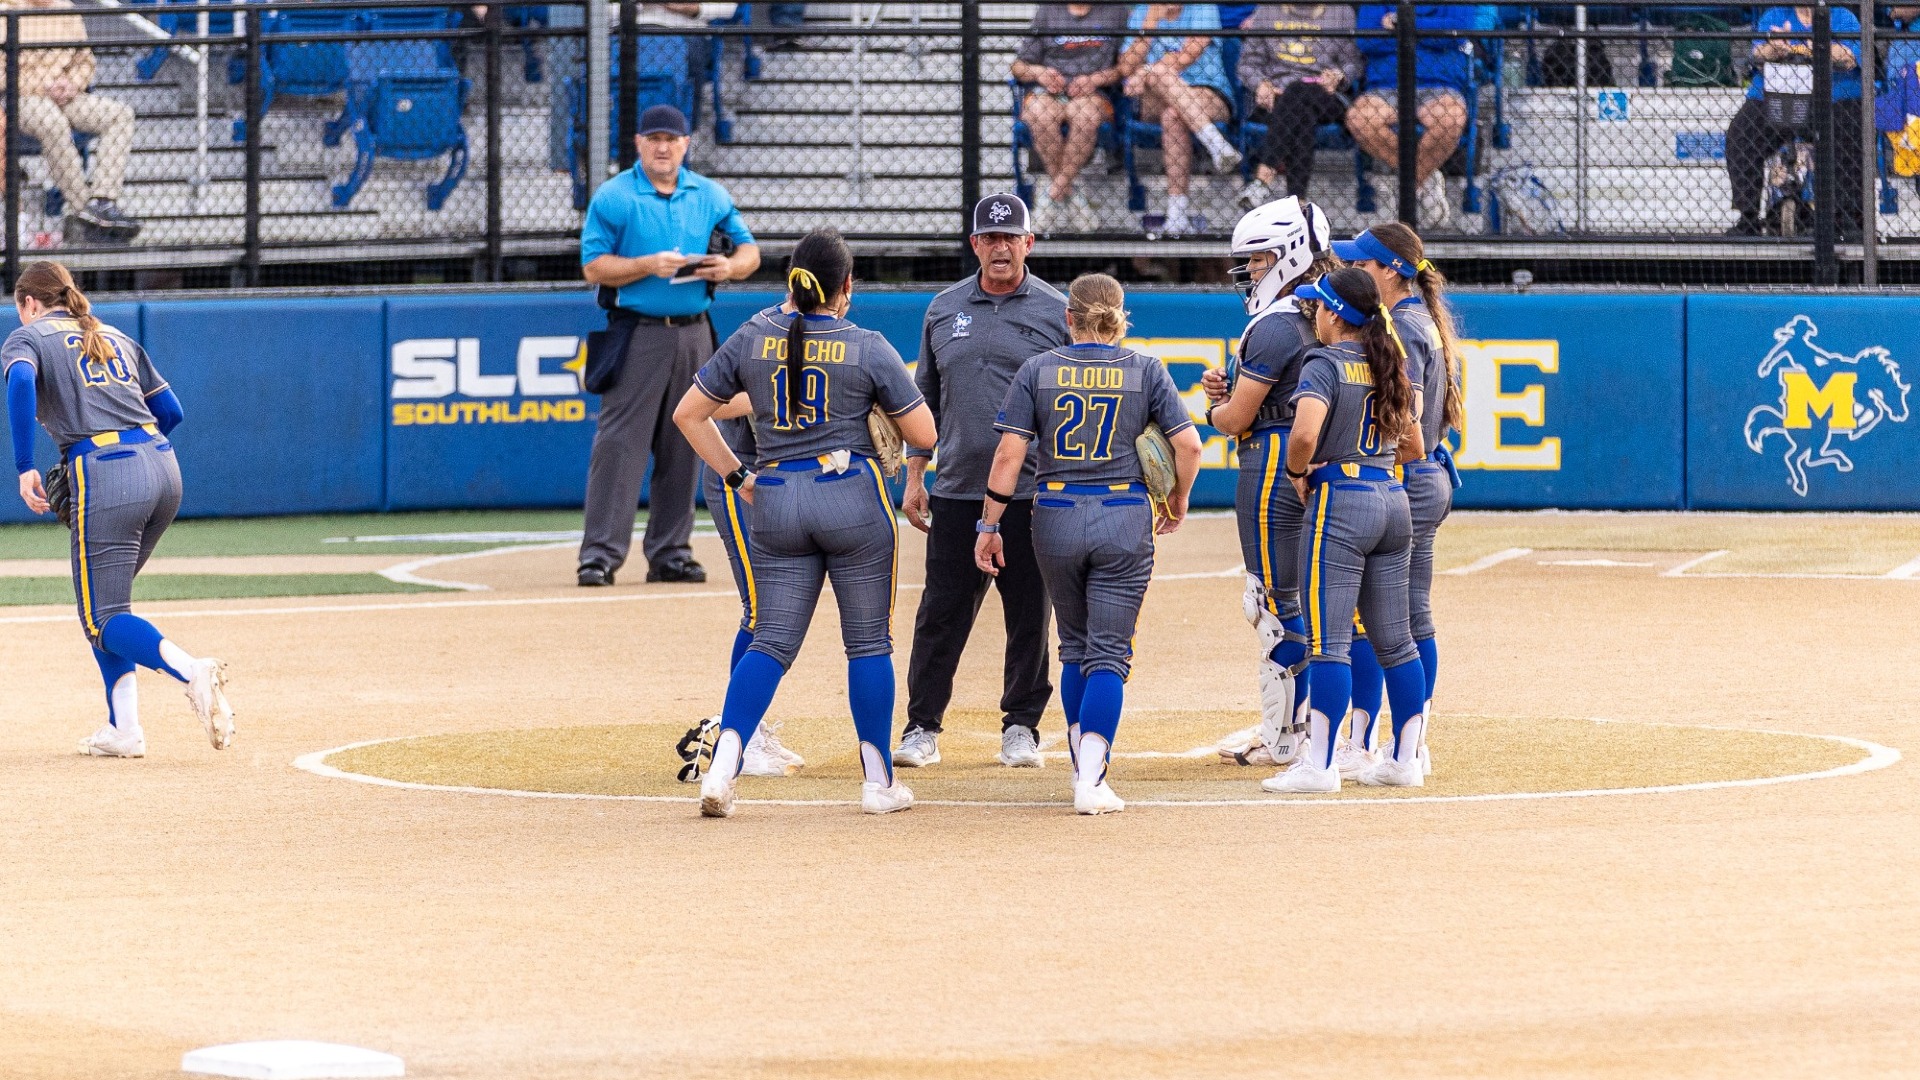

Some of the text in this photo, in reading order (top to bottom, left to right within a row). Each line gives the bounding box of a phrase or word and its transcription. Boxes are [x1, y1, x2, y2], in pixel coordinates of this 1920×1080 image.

[64, 331, 133, 387] 20
[391, 336, 580, 398] SLC
[762, 336, 846, 363] POCHO
[1056, 366, 1124, 389] CLOUD
[392, 400, 586, 426] SOUTHLAND
[771, 365, 830, 430] 19
[1054, 391, 1123, 461] 27
[1357, 390, 1383, 457] 6
[1783, 372, 1858, 429] M
